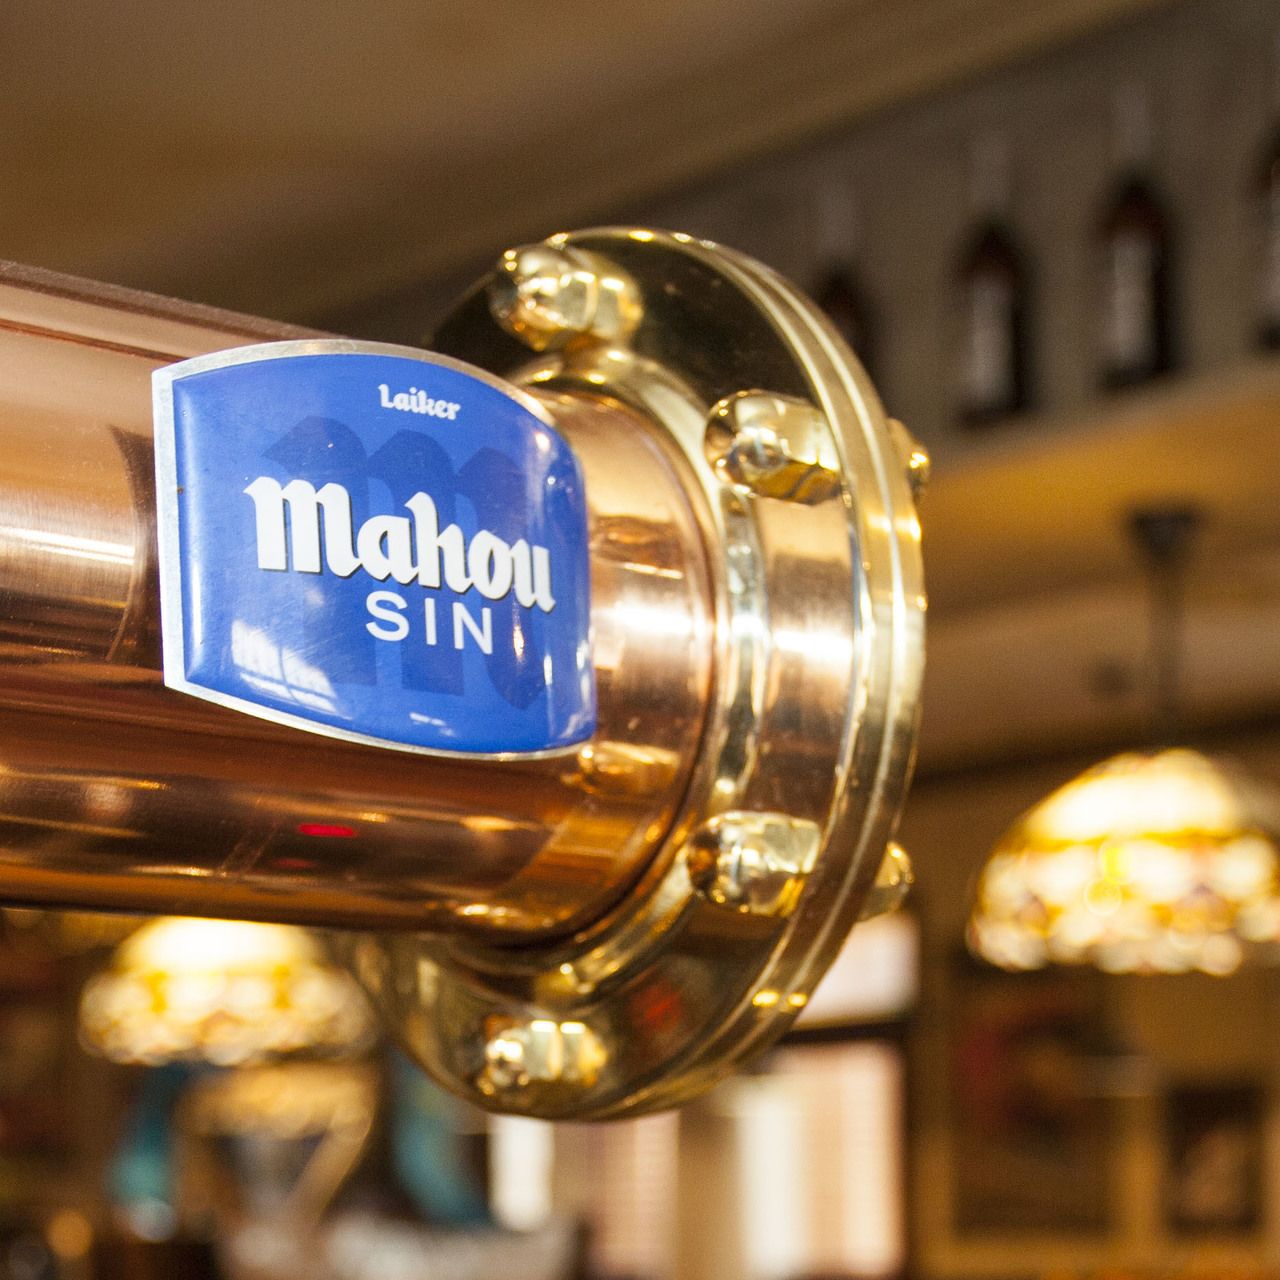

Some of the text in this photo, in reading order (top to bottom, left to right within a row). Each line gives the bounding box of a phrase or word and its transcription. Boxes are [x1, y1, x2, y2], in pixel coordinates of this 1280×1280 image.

[378, 383, 460, 420] Laiker
[243, 476, 556, 612] Mahou
[365, 590, 493, 654] SIN
